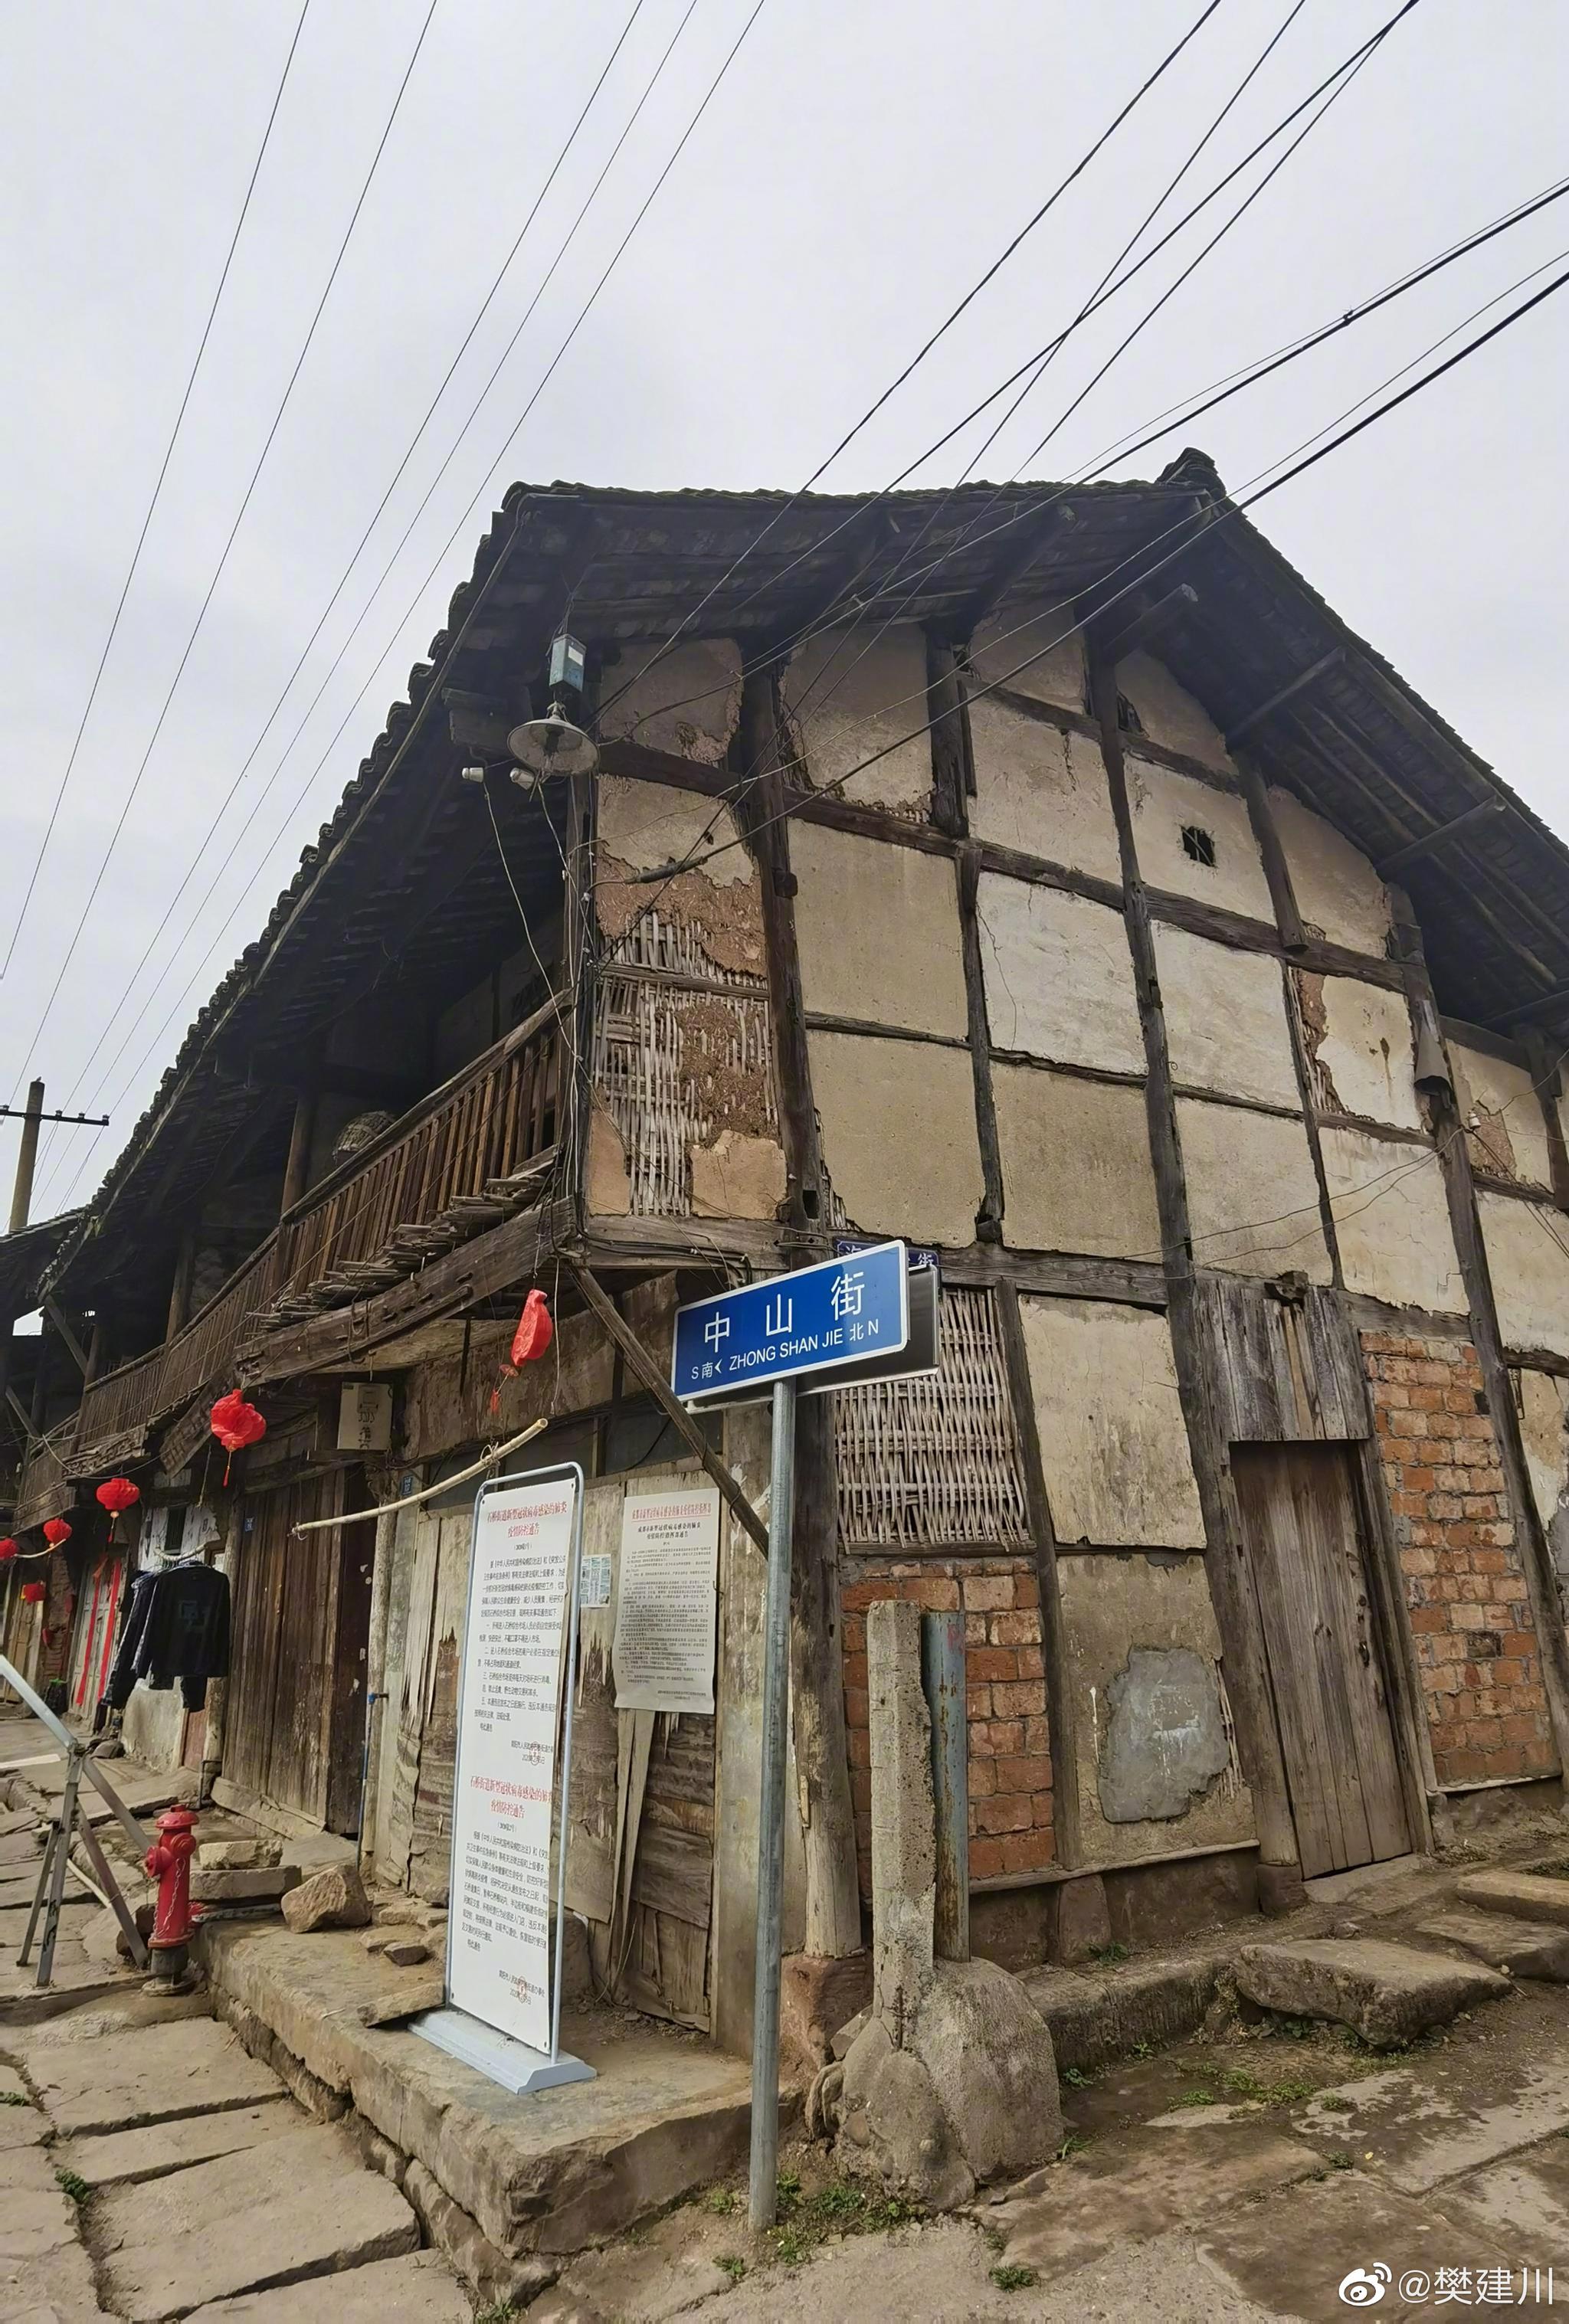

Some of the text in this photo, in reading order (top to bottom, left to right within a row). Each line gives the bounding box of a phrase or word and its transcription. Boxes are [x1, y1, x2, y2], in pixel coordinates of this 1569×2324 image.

[704, 1272, 865, 1353] 中山街
[729, 1346, 776, 1371] ZHONG
[779, 1334, 818, 1358] SHAN
[822, 1327, 843, 1347] JIE
